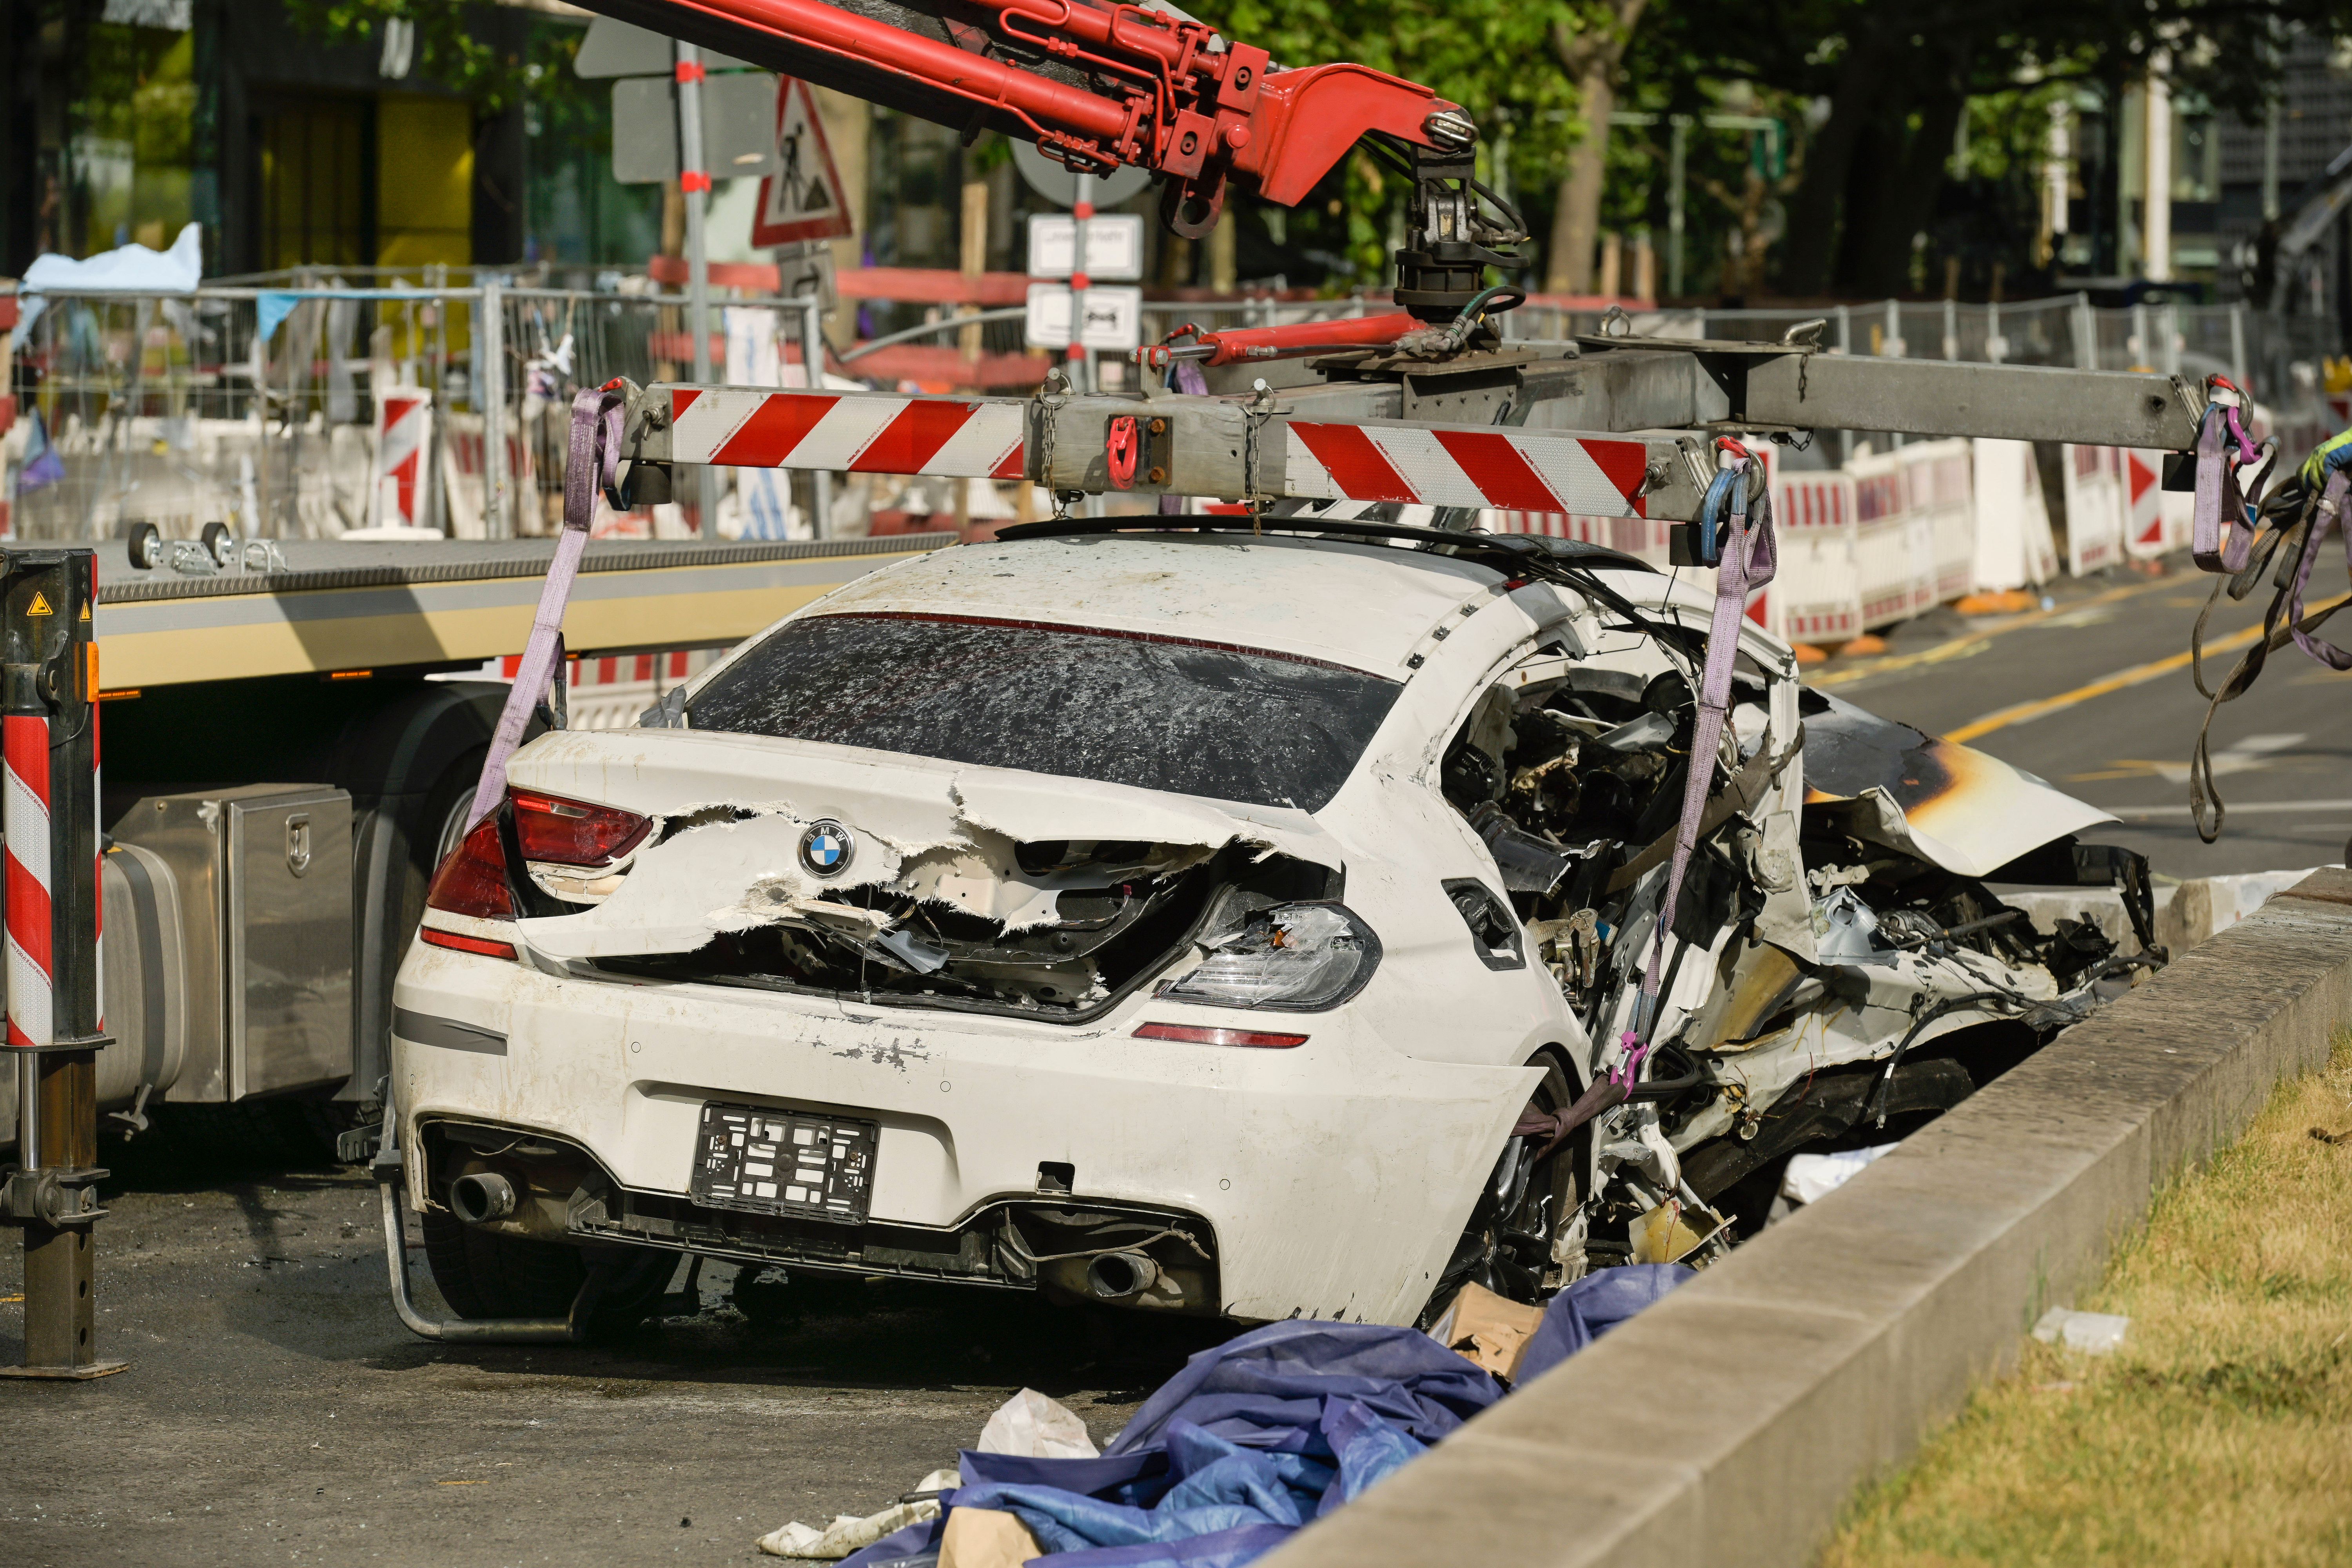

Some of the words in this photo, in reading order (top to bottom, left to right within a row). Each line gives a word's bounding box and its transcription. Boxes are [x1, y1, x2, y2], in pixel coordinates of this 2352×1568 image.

[709, 443, 721, 457] ORALITE
[1376, 440, 1389, 456] ORALITE
[847, 449, 860, 463] ORALITE
[988, 456, 1002, 470] ORALITE
[1521, 449, 1534, 465] ORALITE
[806, 827, 846, 843] BMW
